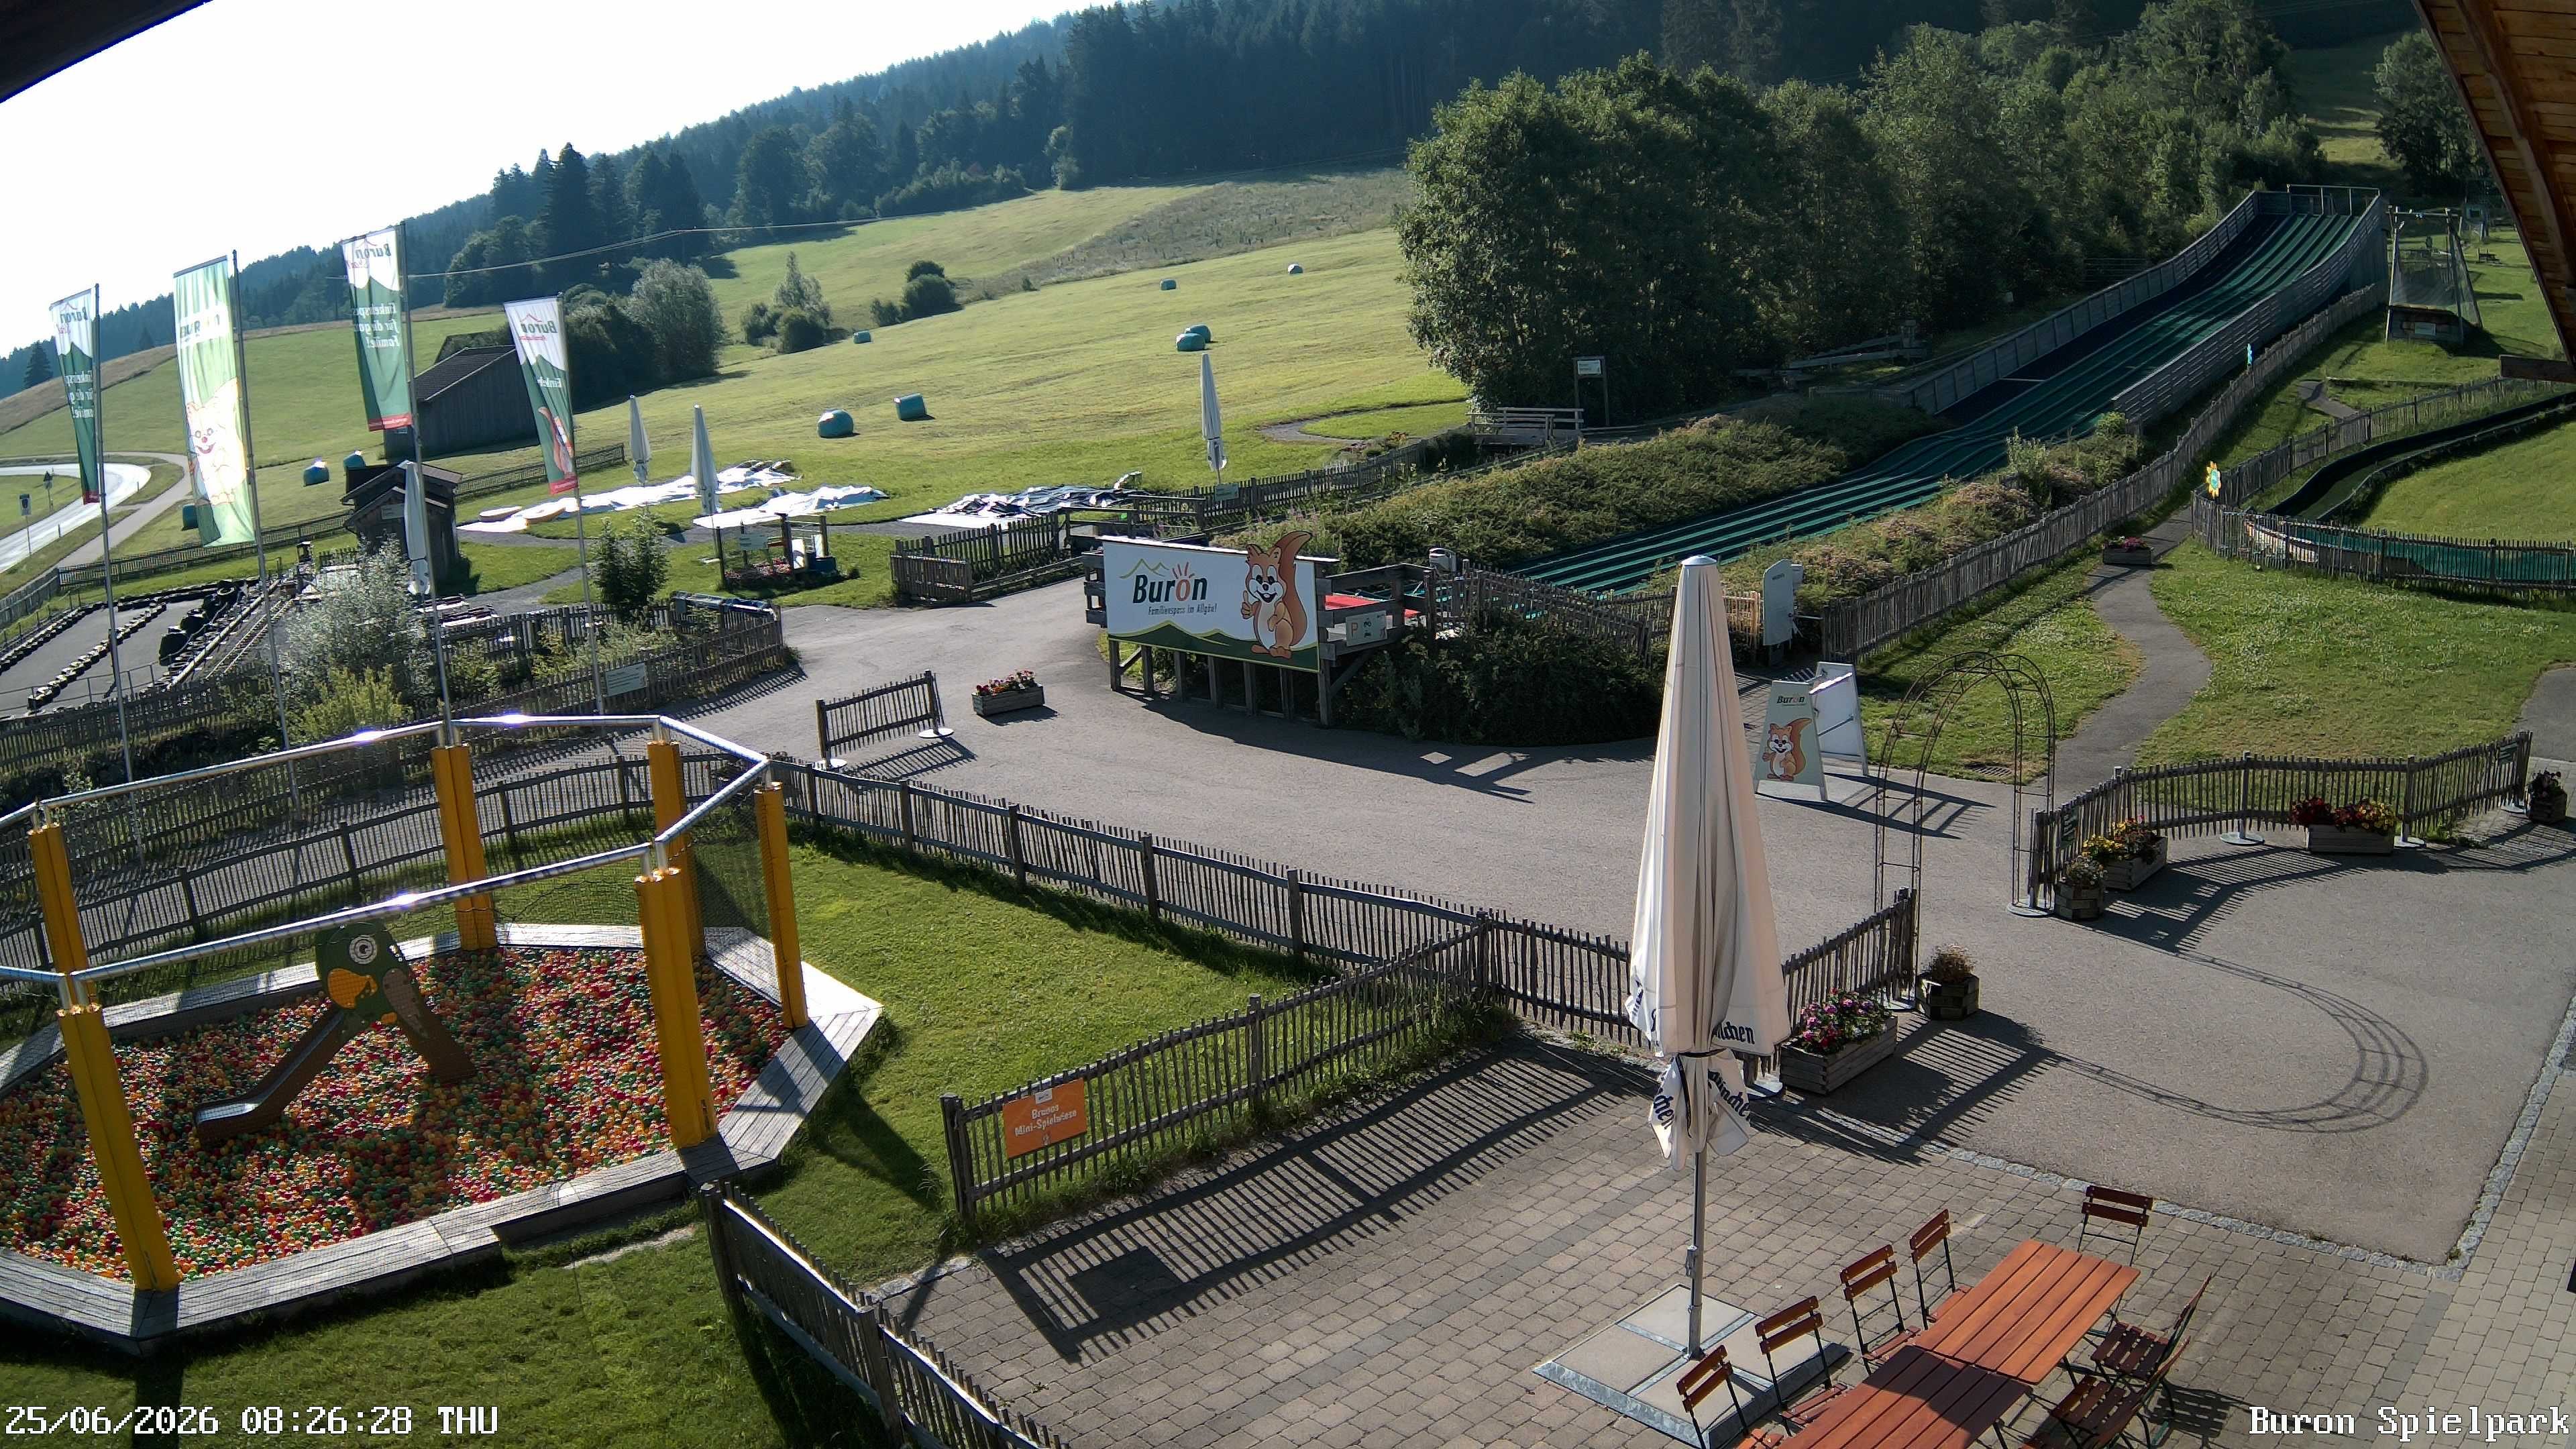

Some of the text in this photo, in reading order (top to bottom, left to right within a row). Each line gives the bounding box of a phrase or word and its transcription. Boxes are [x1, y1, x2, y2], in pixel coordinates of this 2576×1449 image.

[1132, 574, 1208, 604] Buron
[1187, 604, 1194, 613] im
[1776, 696, 1805, 704] Buron
